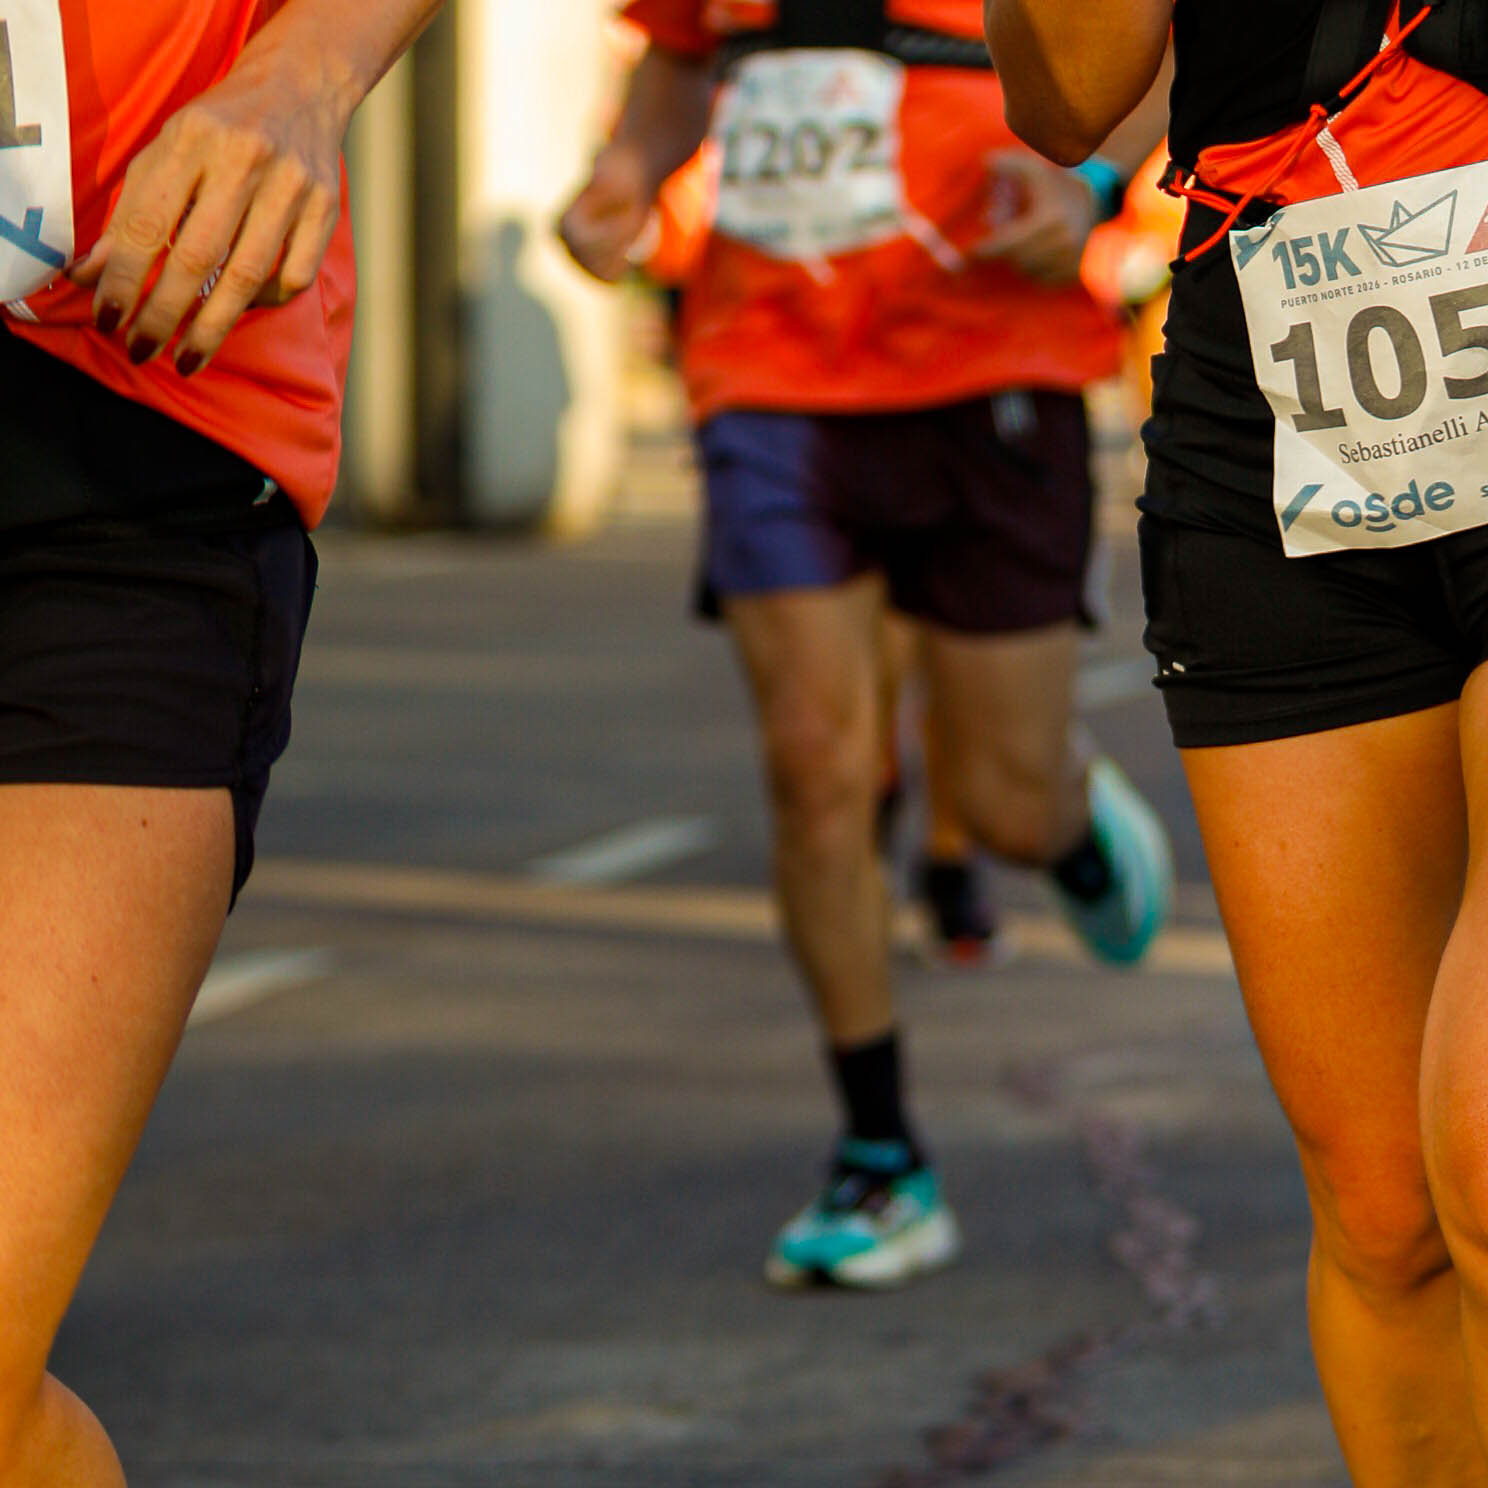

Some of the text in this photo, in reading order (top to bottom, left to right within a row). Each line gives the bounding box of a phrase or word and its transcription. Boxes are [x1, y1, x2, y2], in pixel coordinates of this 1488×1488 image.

[1271, 227, 1363, 290] 15K
[1280, 293, 1319, 309] PUERTO
[1320, 285, 1355, 301] NORTE
[1356, 279, 1381, 294] 2026
[1391, 266, 1443, 286] ROSARIO
[1456, 259, 1470, 272] 12
[1474, 255, 1488, 268] DE
[1338, 416, 1469, 464] Sebastianelli
[1331, 479, 1455, 530] osde
